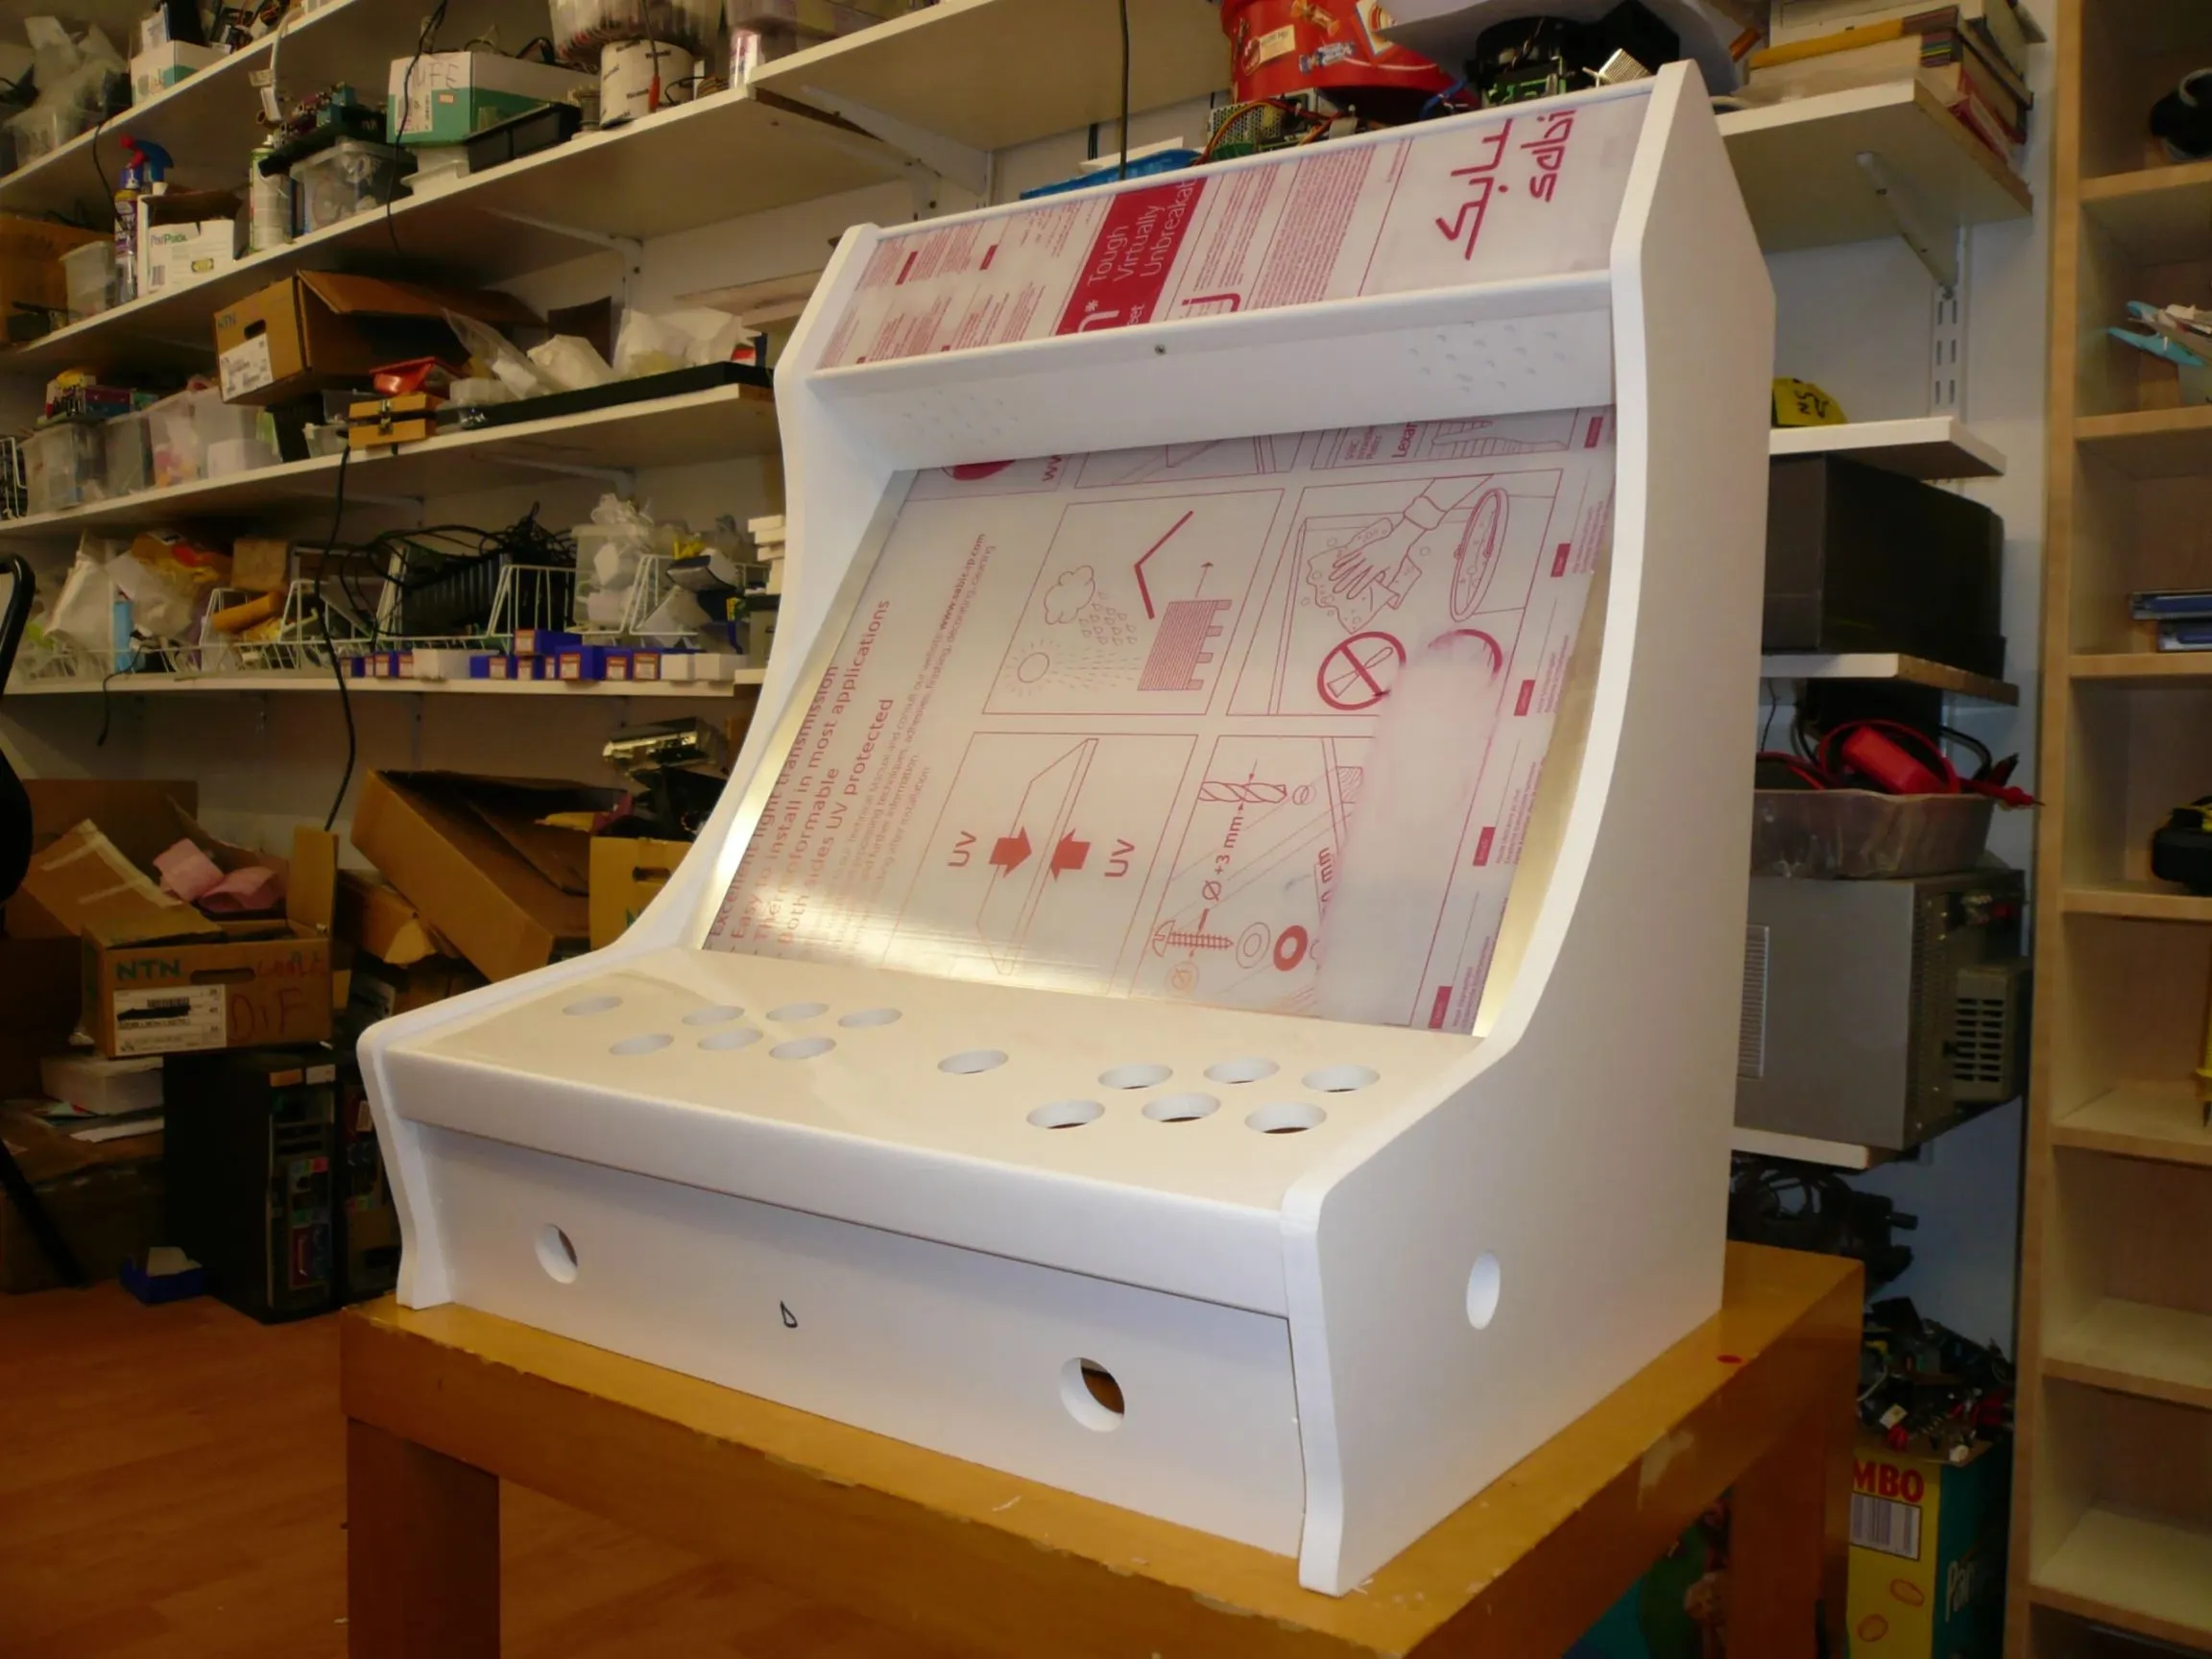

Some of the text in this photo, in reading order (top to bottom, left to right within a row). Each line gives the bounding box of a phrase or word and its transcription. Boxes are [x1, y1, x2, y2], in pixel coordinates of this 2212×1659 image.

[1087, 225, 1130, 286] Tough
[1113, 204, 1166, 281] Virtually
[776, 664, 839, 785] transmission
[731, 894, 763, 939] Easy
[766, 799, 803, 860] install
[798, 774, 813, 794] in
[807, 720, 837, 768] most
[831, 599, 890, 715] applications
[753, 767, 840, 942] Thermoformable
[778, 894, 809, 945] Both
[805, 836, 835, 888] sides
[825, 802, 849, 830] UV
[843, 698, 894, 796] protected
[948, 830, 977, 867] UV
[1214, 854, 1231, 876] +3
[1223, 815, 1243, 849] mm
[1104, 839, 1136, 878] UV
[116, 958, 181, 980] NTN
